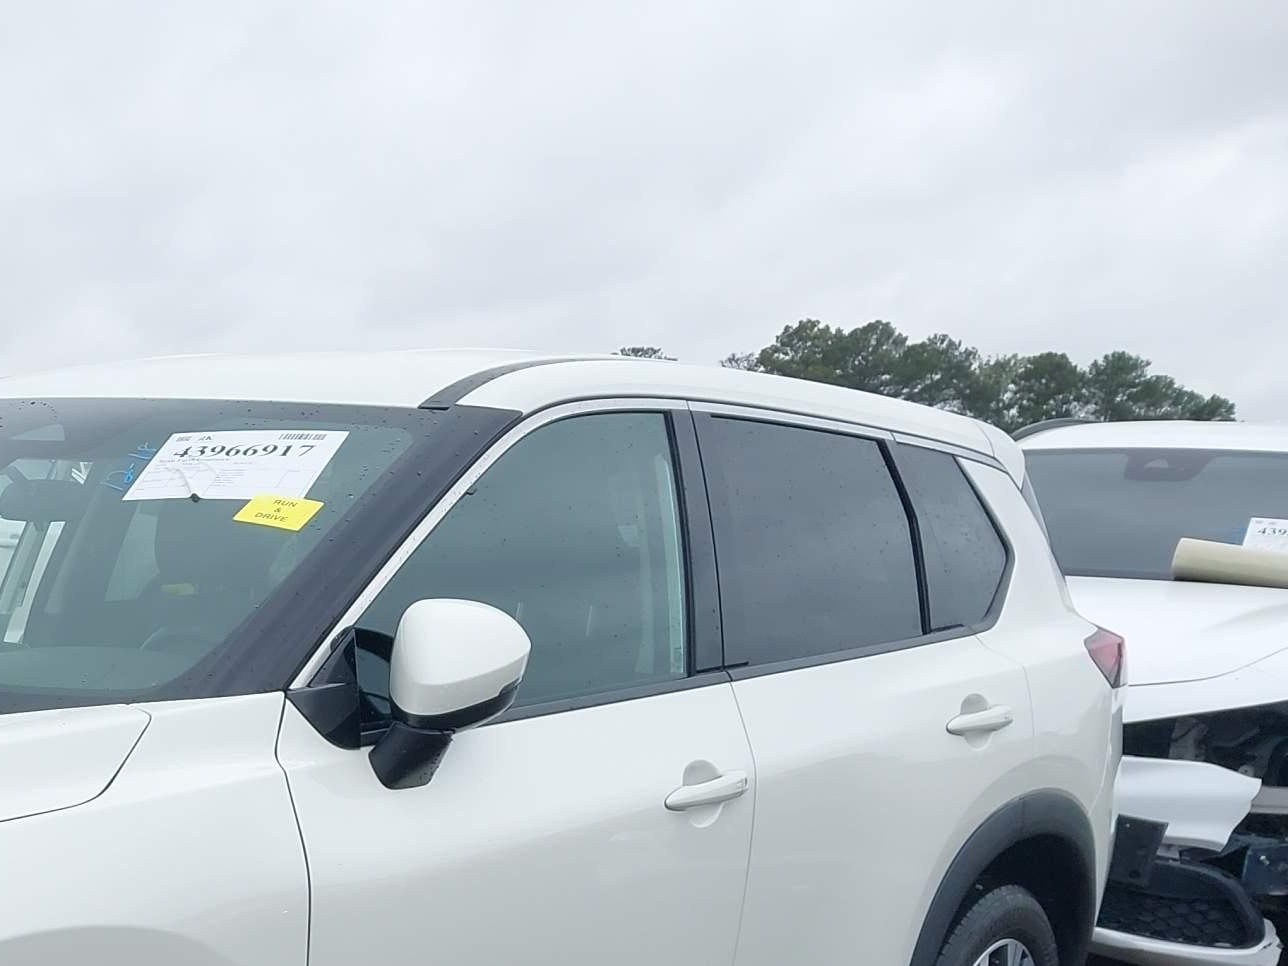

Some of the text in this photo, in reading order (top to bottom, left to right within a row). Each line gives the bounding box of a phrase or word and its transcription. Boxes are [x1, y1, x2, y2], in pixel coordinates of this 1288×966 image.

[173, 444, 318, 458] 43966917
[273, 499, 299, 508] RUN
[254, 512, 289, 522] DRIVE
